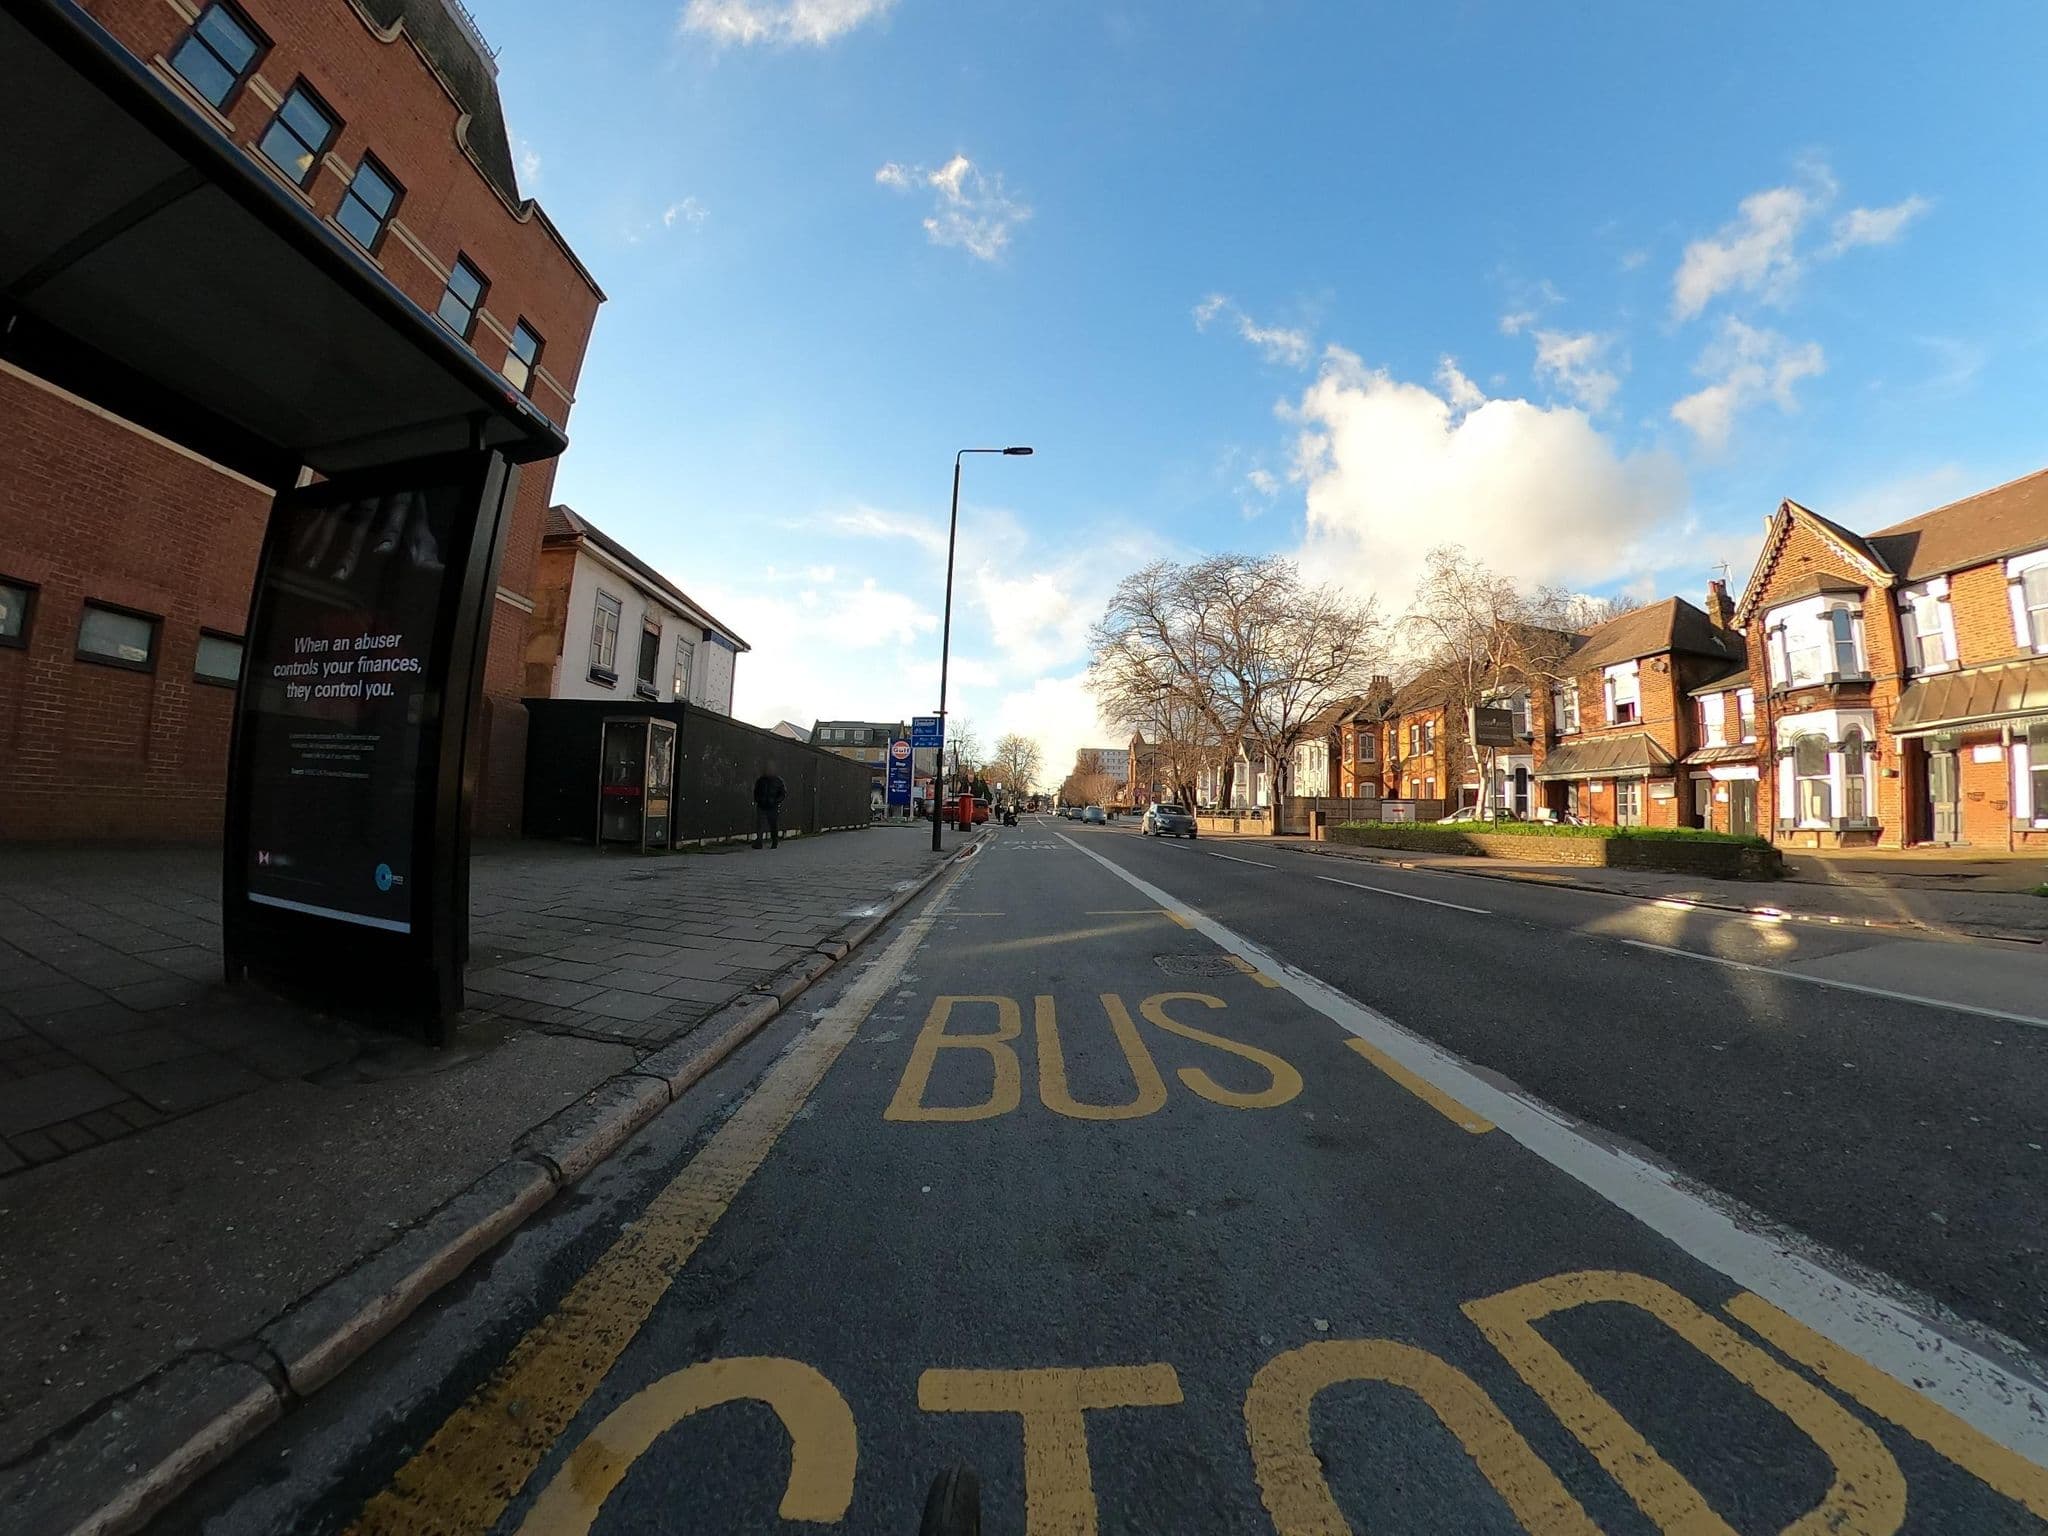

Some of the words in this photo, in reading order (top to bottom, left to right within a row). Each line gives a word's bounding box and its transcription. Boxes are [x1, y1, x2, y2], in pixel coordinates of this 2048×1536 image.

[294, 637, 329, 653] When
[332, 638, 350, 651] an
[354, 633, 402, 650] abuser
[273, 659, 318, 677] controls
[322, 661, 354, 678] your
[357, 656, 422, 675] finances,
[286, 682, 312, 702] they
[314, 680, 363, 698] control
[366, 682, 395, 700] you.
[883, 992, 1304, 1122] BUS
